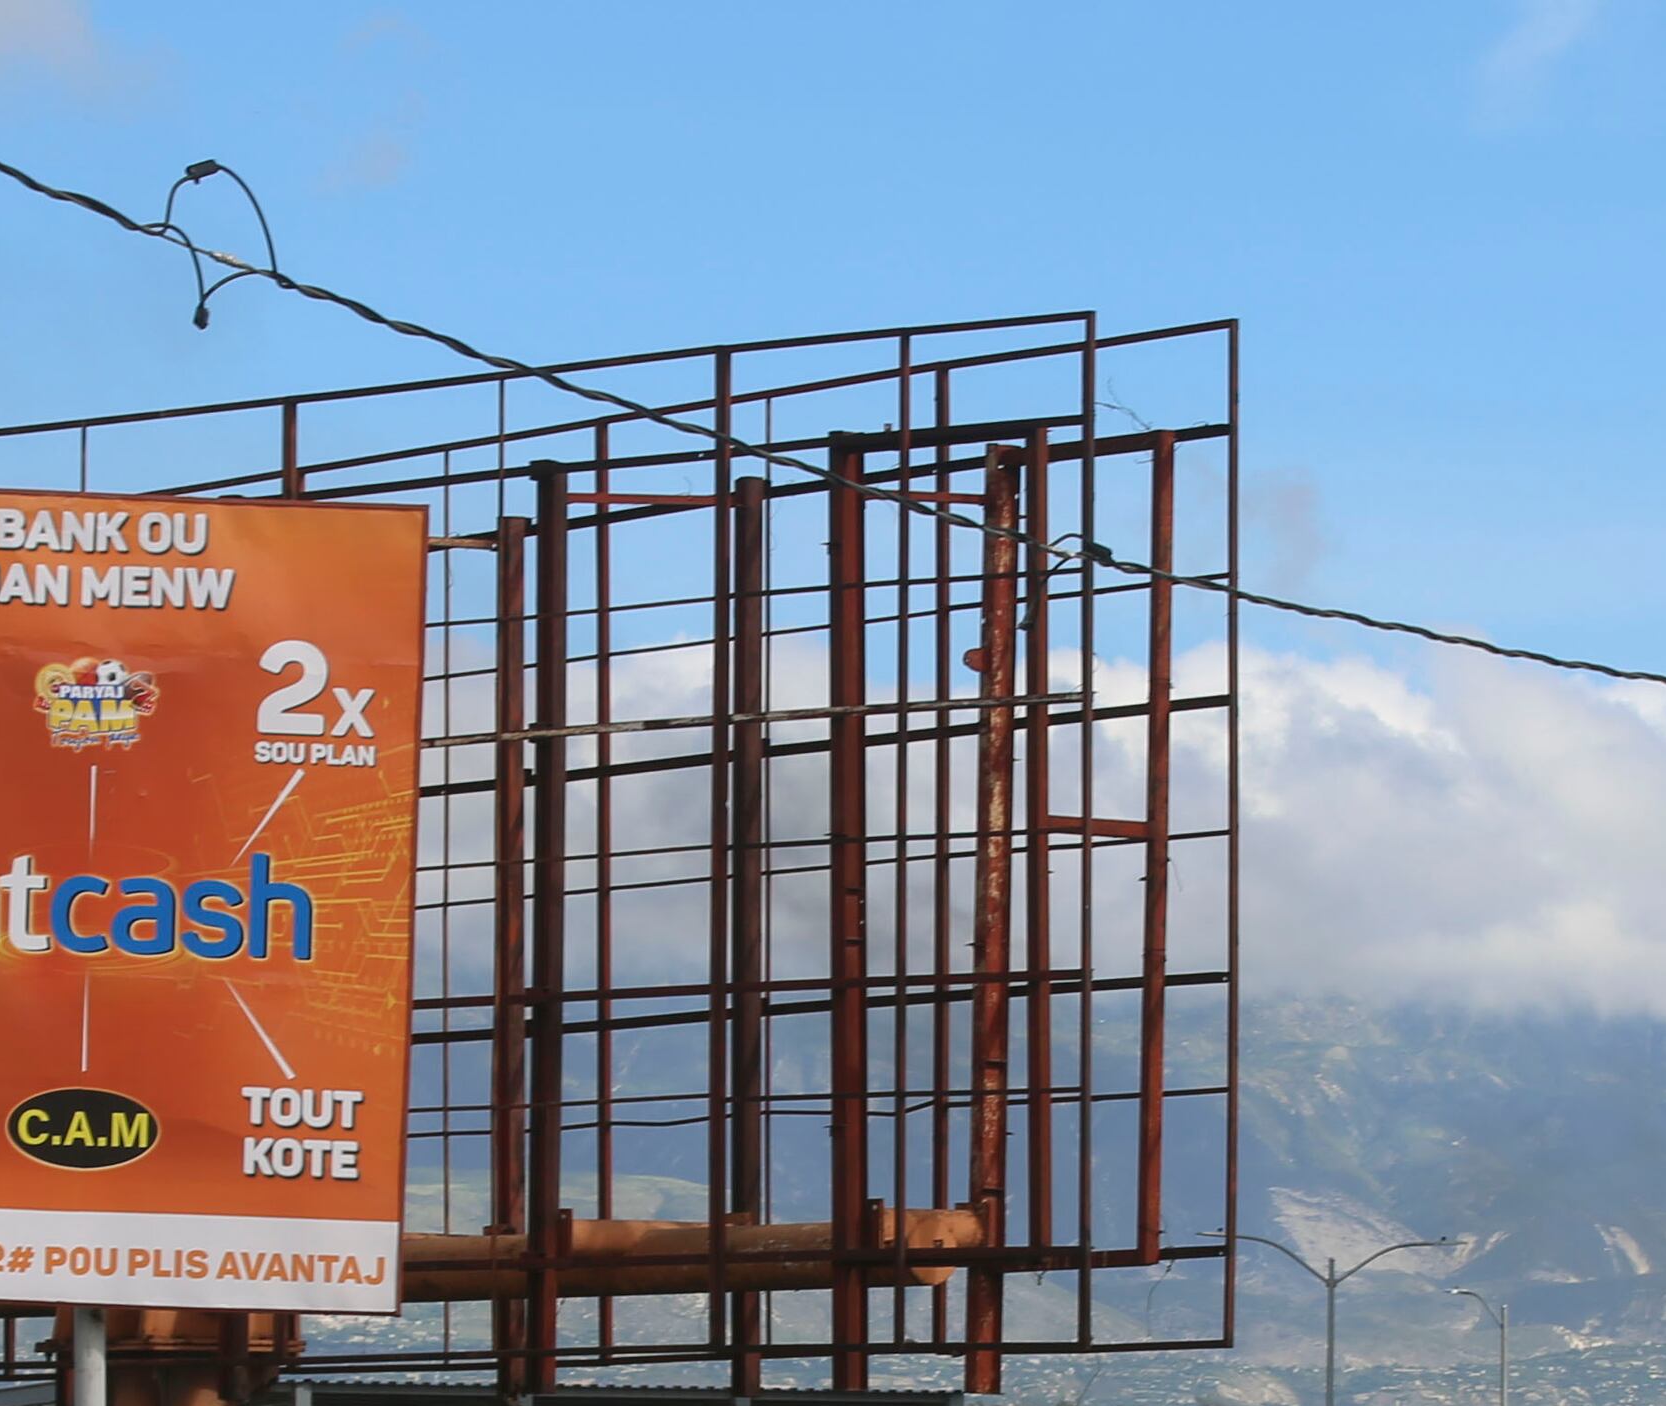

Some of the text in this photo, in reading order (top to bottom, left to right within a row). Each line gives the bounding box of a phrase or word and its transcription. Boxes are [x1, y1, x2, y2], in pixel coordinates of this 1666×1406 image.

[137, 511, 209, 555] OU
[80, 565, 235, 610] MENW
[257, 639, 375, 738] 2x
[49, 698, 136, 732] PAM
[255, 741, 376, 767] SOU PLAN
[17, 1108, 149, 1149] C.A.M
[241, 1086, 364, 1130] TOUT
[243, 1136, 360, 1180] KOTE
[44, 1246, 119, 1277] POU
[128, 1248, 209, 1279] PLIS
[217, 1251, 386, 1285] AVANTAJ
